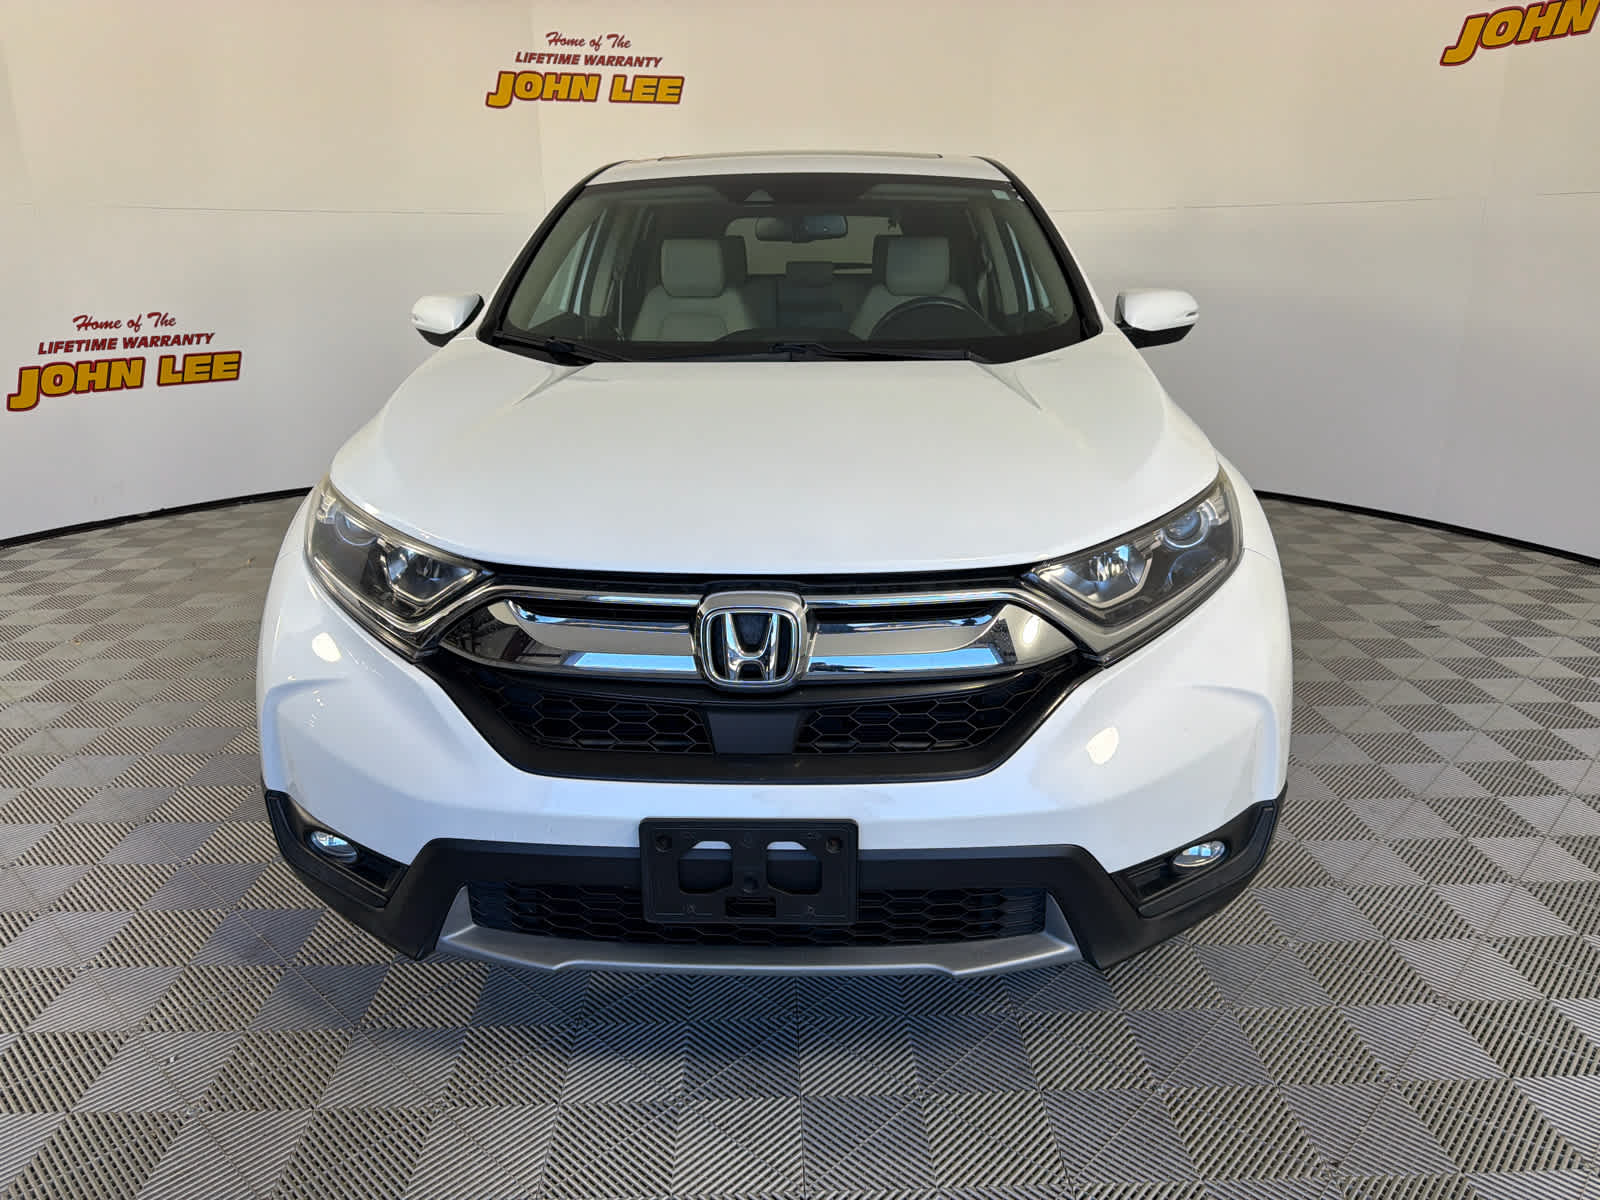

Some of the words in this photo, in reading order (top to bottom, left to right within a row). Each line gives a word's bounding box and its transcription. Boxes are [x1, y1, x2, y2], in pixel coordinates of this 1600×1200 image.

[545, 31, 585, 48] Home
[589, 35, 602, 50] of
[606, 33, 631, 49] The
[1439, 0, 1600, 66] JOHN
[515, 51, 580, 66] LIFETIME
[584, 54, 663, 68] WARRANTY
[485, 70, 601, 109] JOHN
[608, 74, 685, 104] LEE
[72, 314, 122, 331] Home
[126, 314, 142, 332] of
[147, 311, 176, 328] The
[37, 337, 118, 355] LIFETIME
[122, 332, 215, 350] WARRANTY
[6, 356, 146, 412] JOHN
[157, 350, 242, 387] LEE
